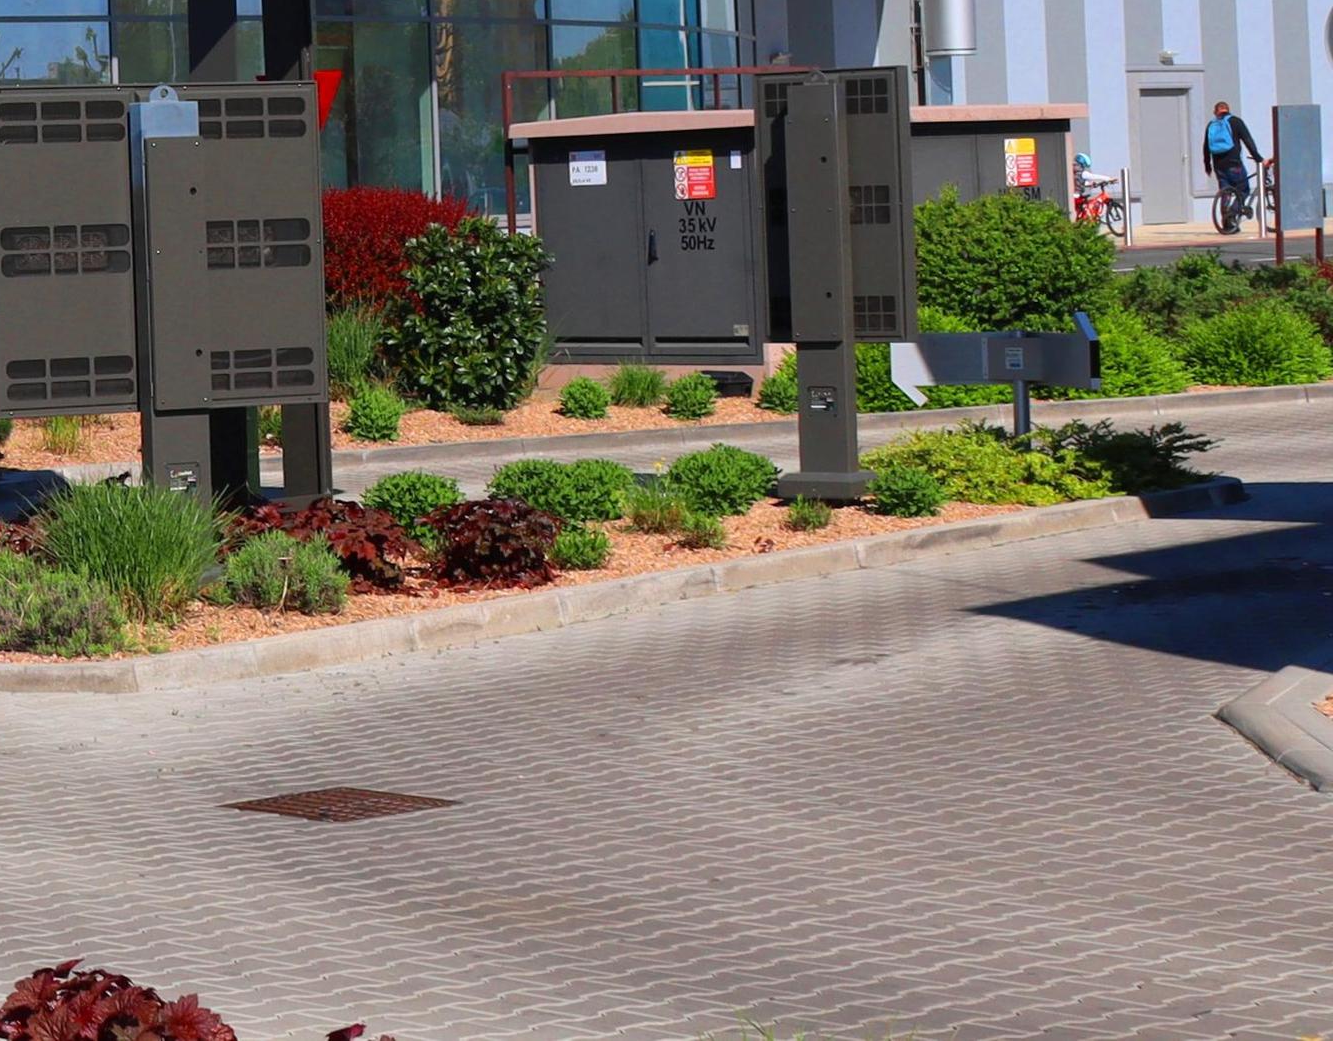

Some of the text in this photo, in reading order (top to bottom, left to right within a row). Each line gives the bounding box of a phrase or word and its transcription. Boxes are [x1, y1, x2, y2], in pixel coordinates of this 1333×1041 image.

[684, 201, 706, 216] VN
[678, 217, 717, 234] 35 kV
[681, 235, 715, 250] 50Hz
